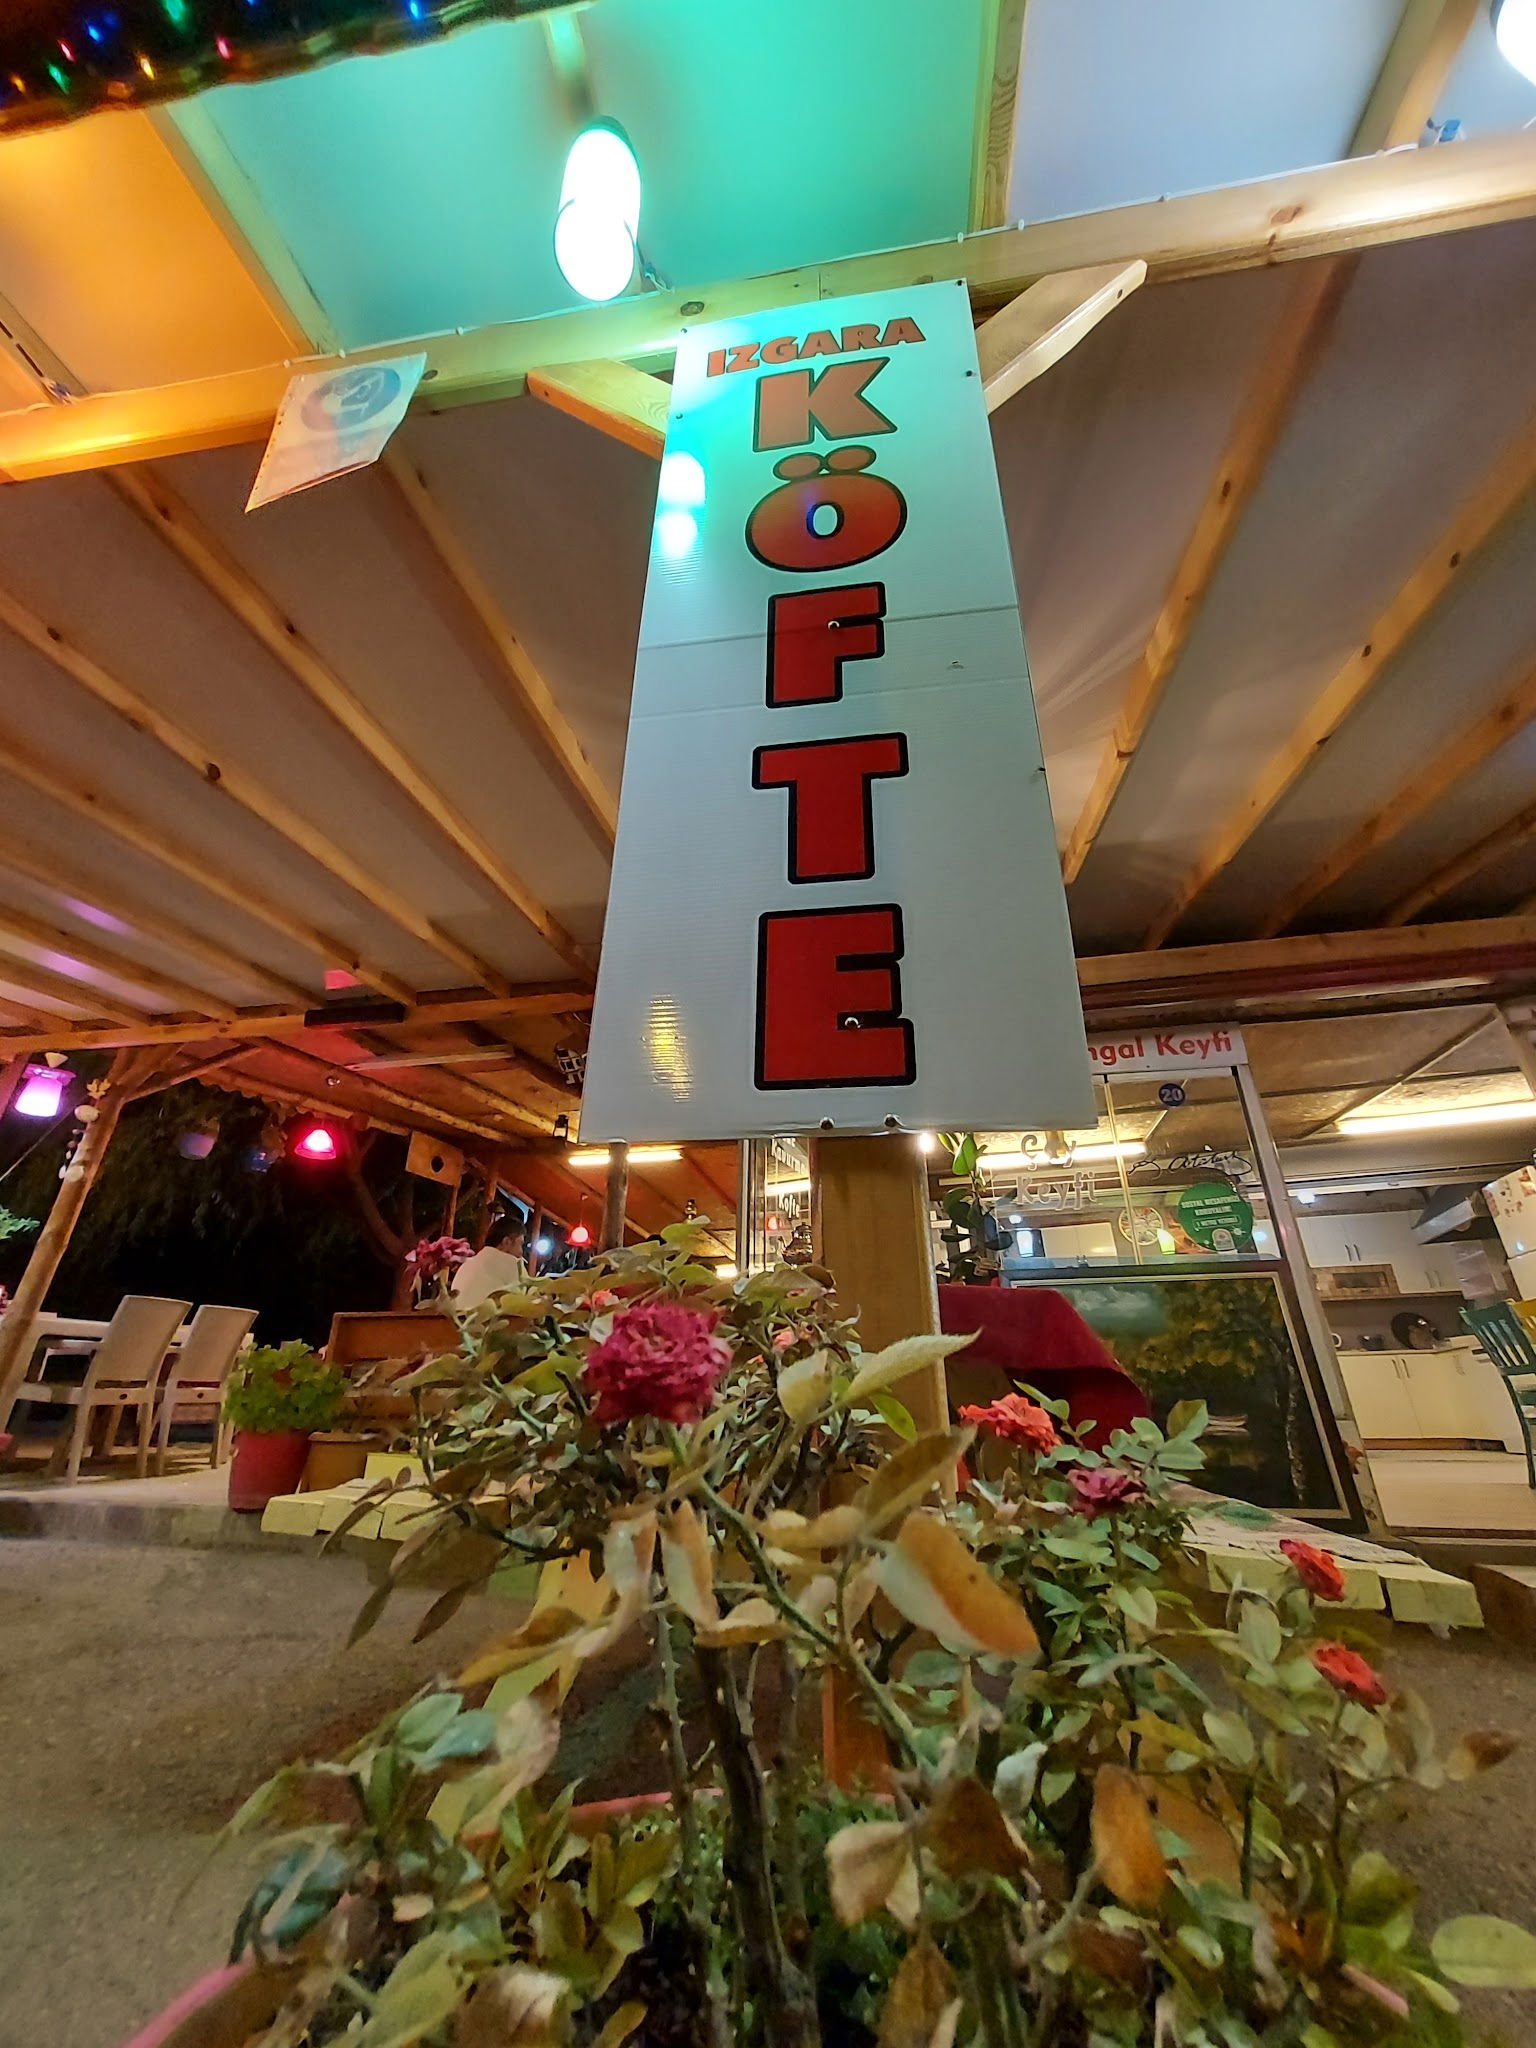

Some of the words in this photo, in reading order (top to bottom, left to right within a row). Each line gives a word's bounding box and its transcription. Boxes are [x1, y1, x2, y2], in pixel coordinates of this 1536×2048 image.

[707, 317, 926, 377] IZGARA
[745, 357, 917, 1091] KÖFTE
[1155, 1030, 1232, 1060] Keyfi
[1160, 1087, 1183, 1102] 20
[1021, 1134, 1077, 1171] Çy
[1016, 1171, 1097, 1211] Keyfi
